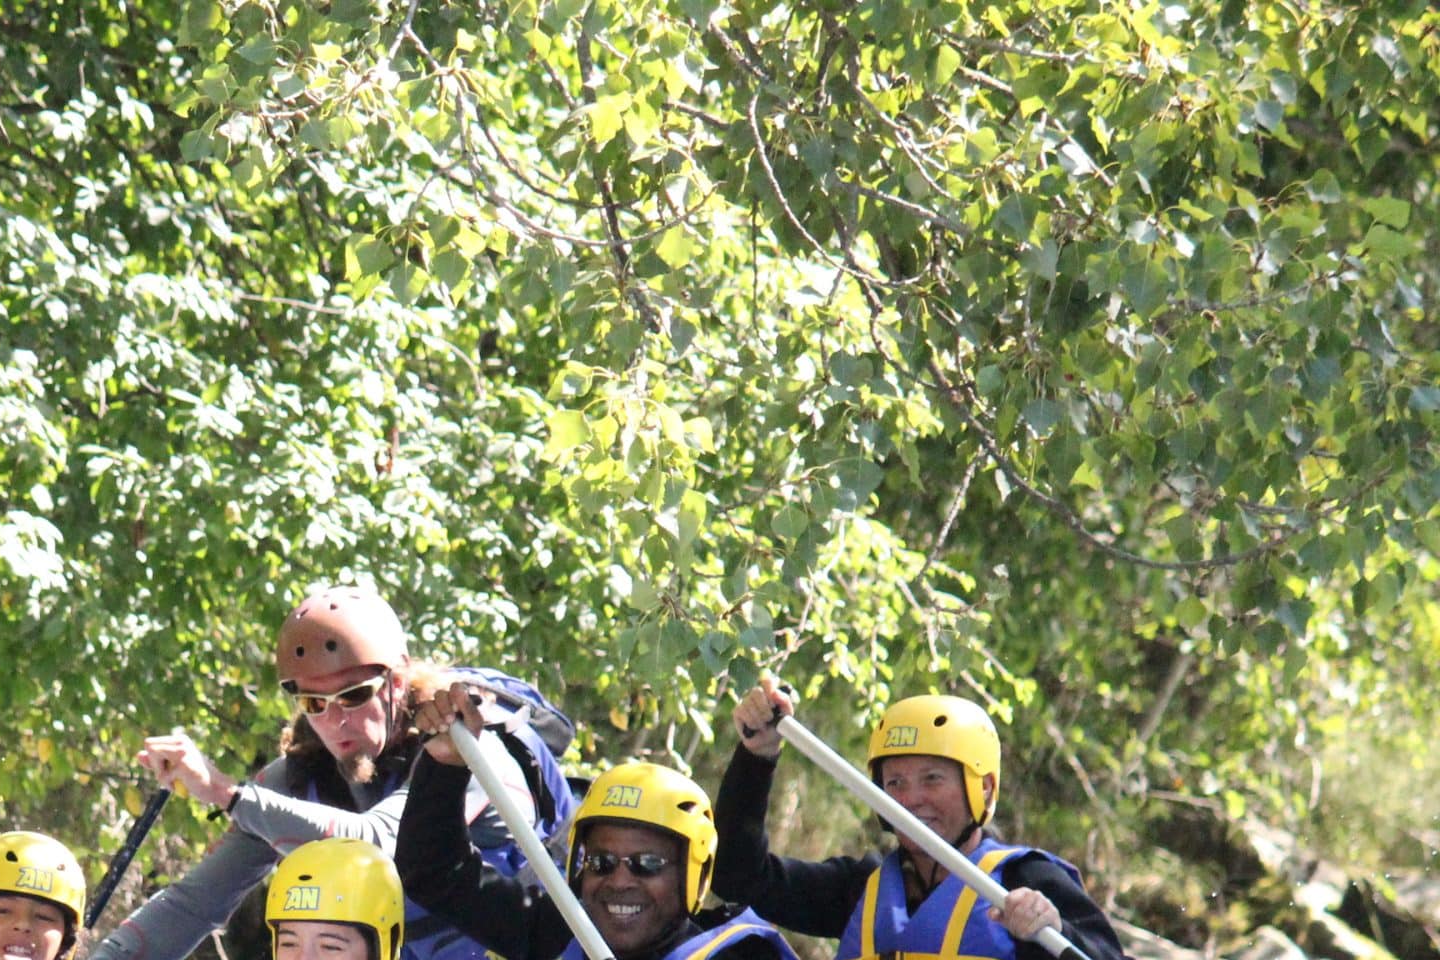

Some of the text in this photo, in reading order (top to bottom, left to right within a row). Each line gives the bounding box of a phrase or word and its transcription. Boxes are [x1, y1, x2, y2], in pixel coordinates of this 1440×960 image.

[883, 727, 918, 749] AN
[602, 785, 642, 809] AN
[16, 867, 53, 893] AN
[283, 886, 320, 911] AN
